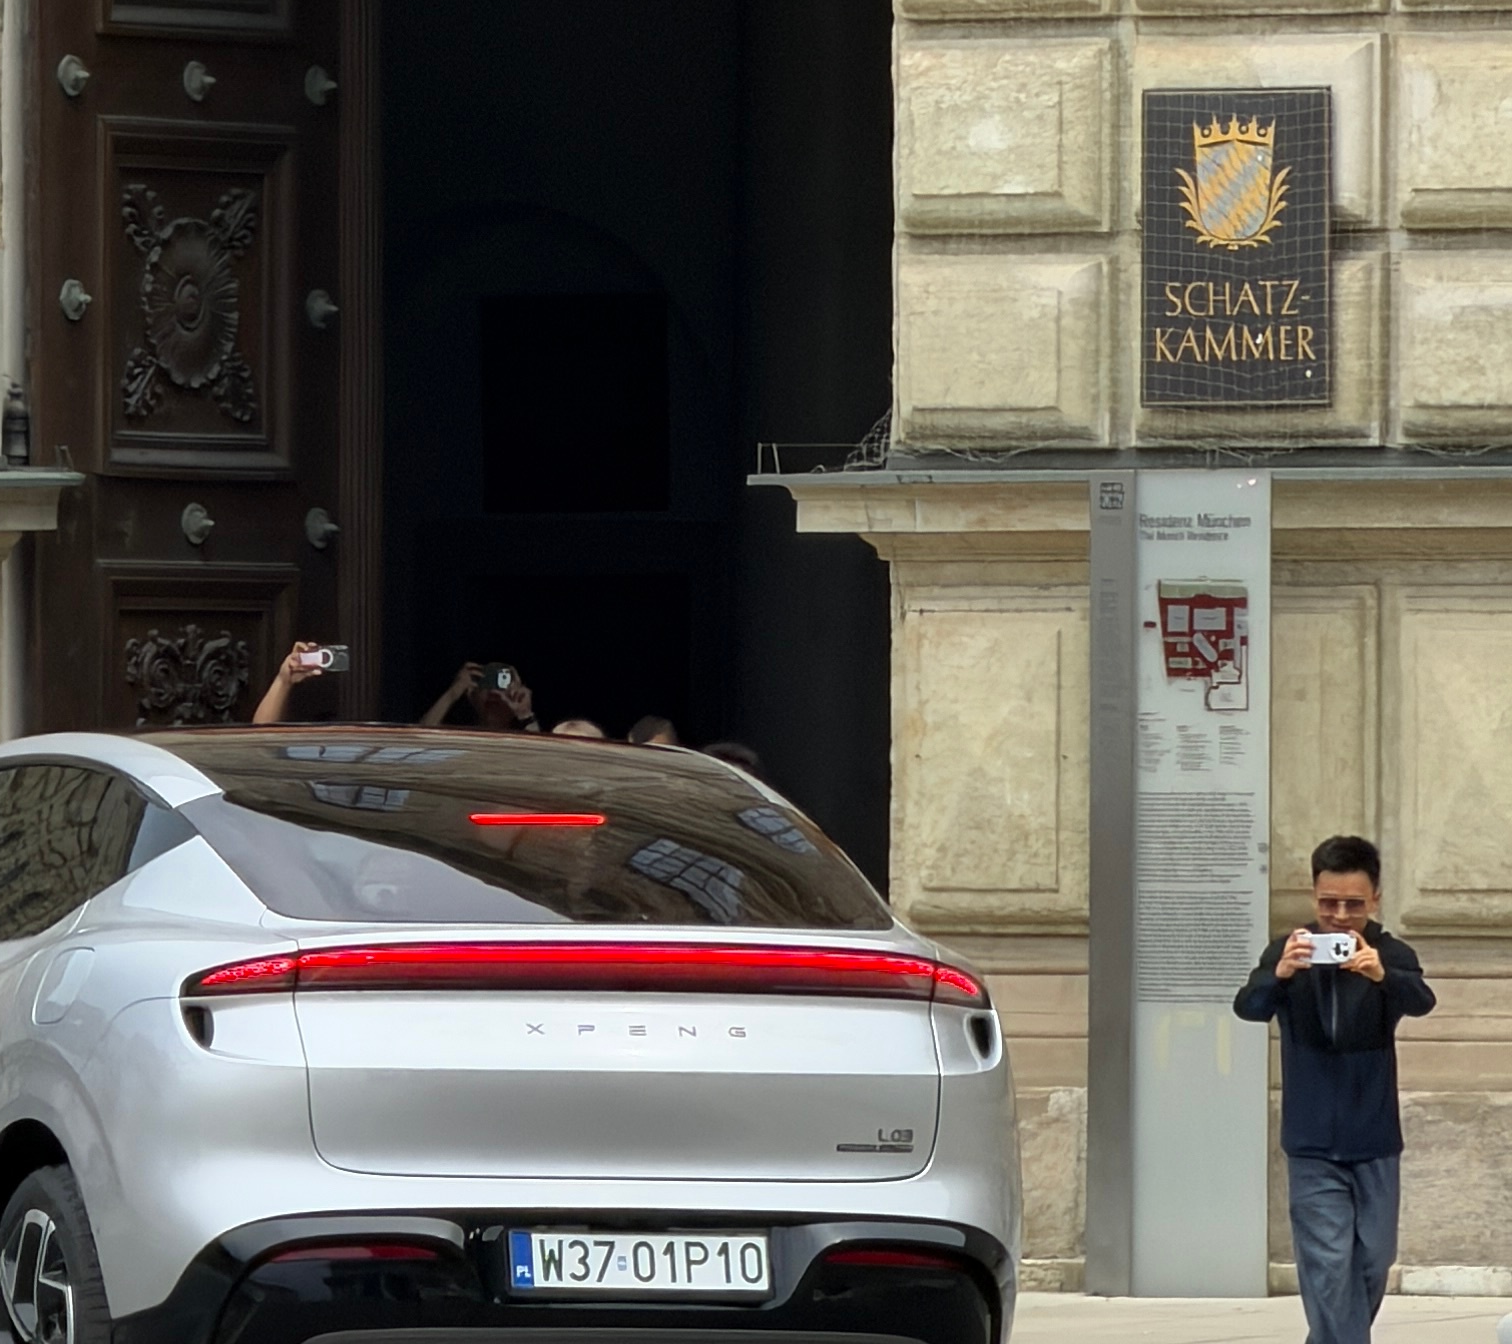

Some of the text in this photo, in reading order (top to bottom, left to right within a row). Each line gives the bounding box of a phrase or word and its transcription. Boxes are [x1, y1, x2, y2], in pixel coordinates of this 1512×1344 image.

[1164, 278, 1312, 318] SCHATZ-
[1154, 323, 1317, 363] KAMMER
[524, 1022, 747, 1039] XPENG
[516, 1265, 532, 1279] PL
